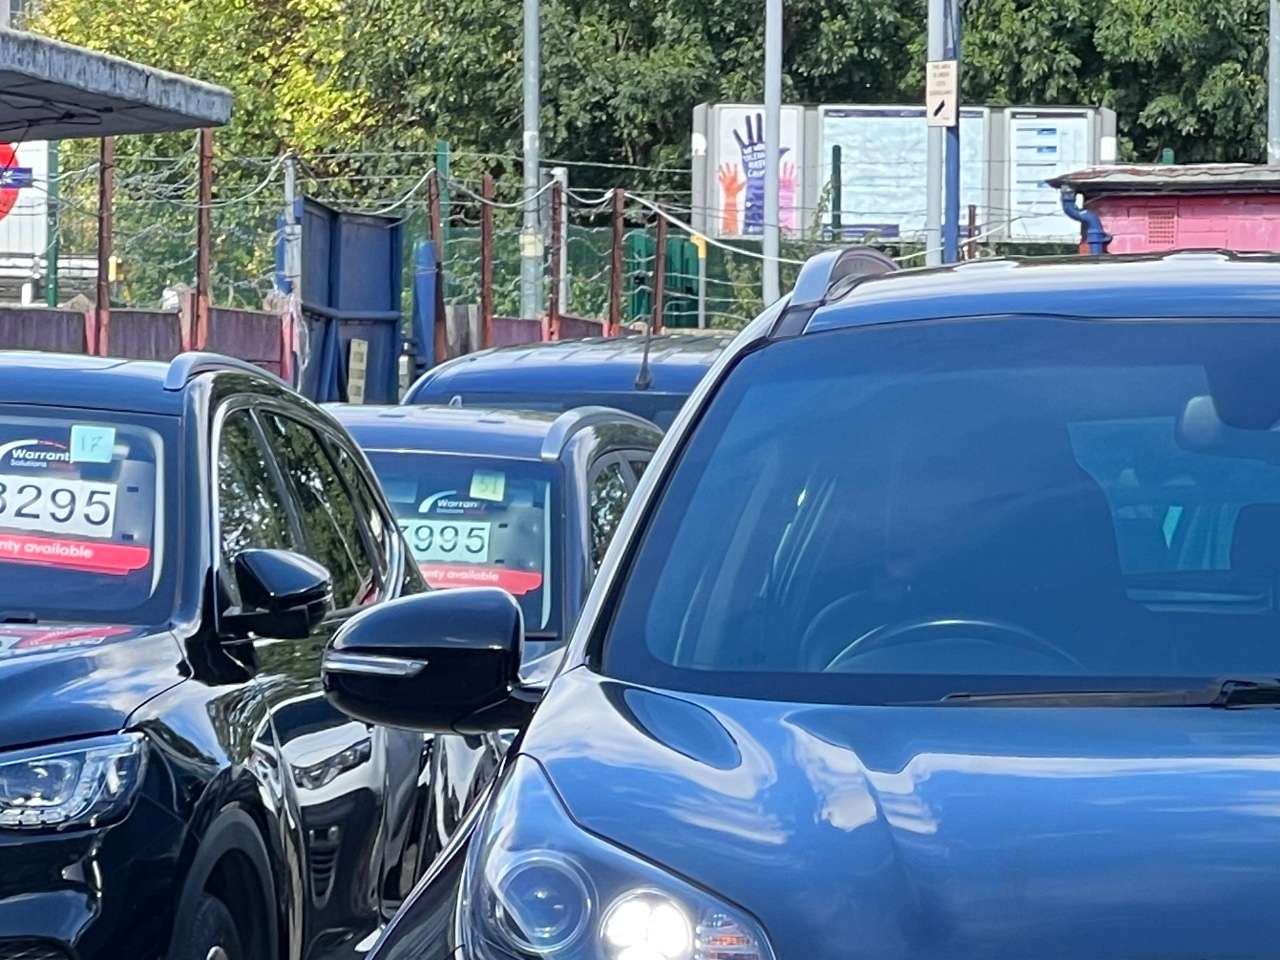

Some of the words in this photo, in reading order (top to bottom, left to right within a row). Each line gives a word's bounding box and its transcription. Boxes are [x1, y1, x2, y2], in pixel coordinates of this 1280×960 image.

[12, 449, 72, 462] Warrant
[24, 542, 93, 559] available
[447, 571, 500, 581] available
